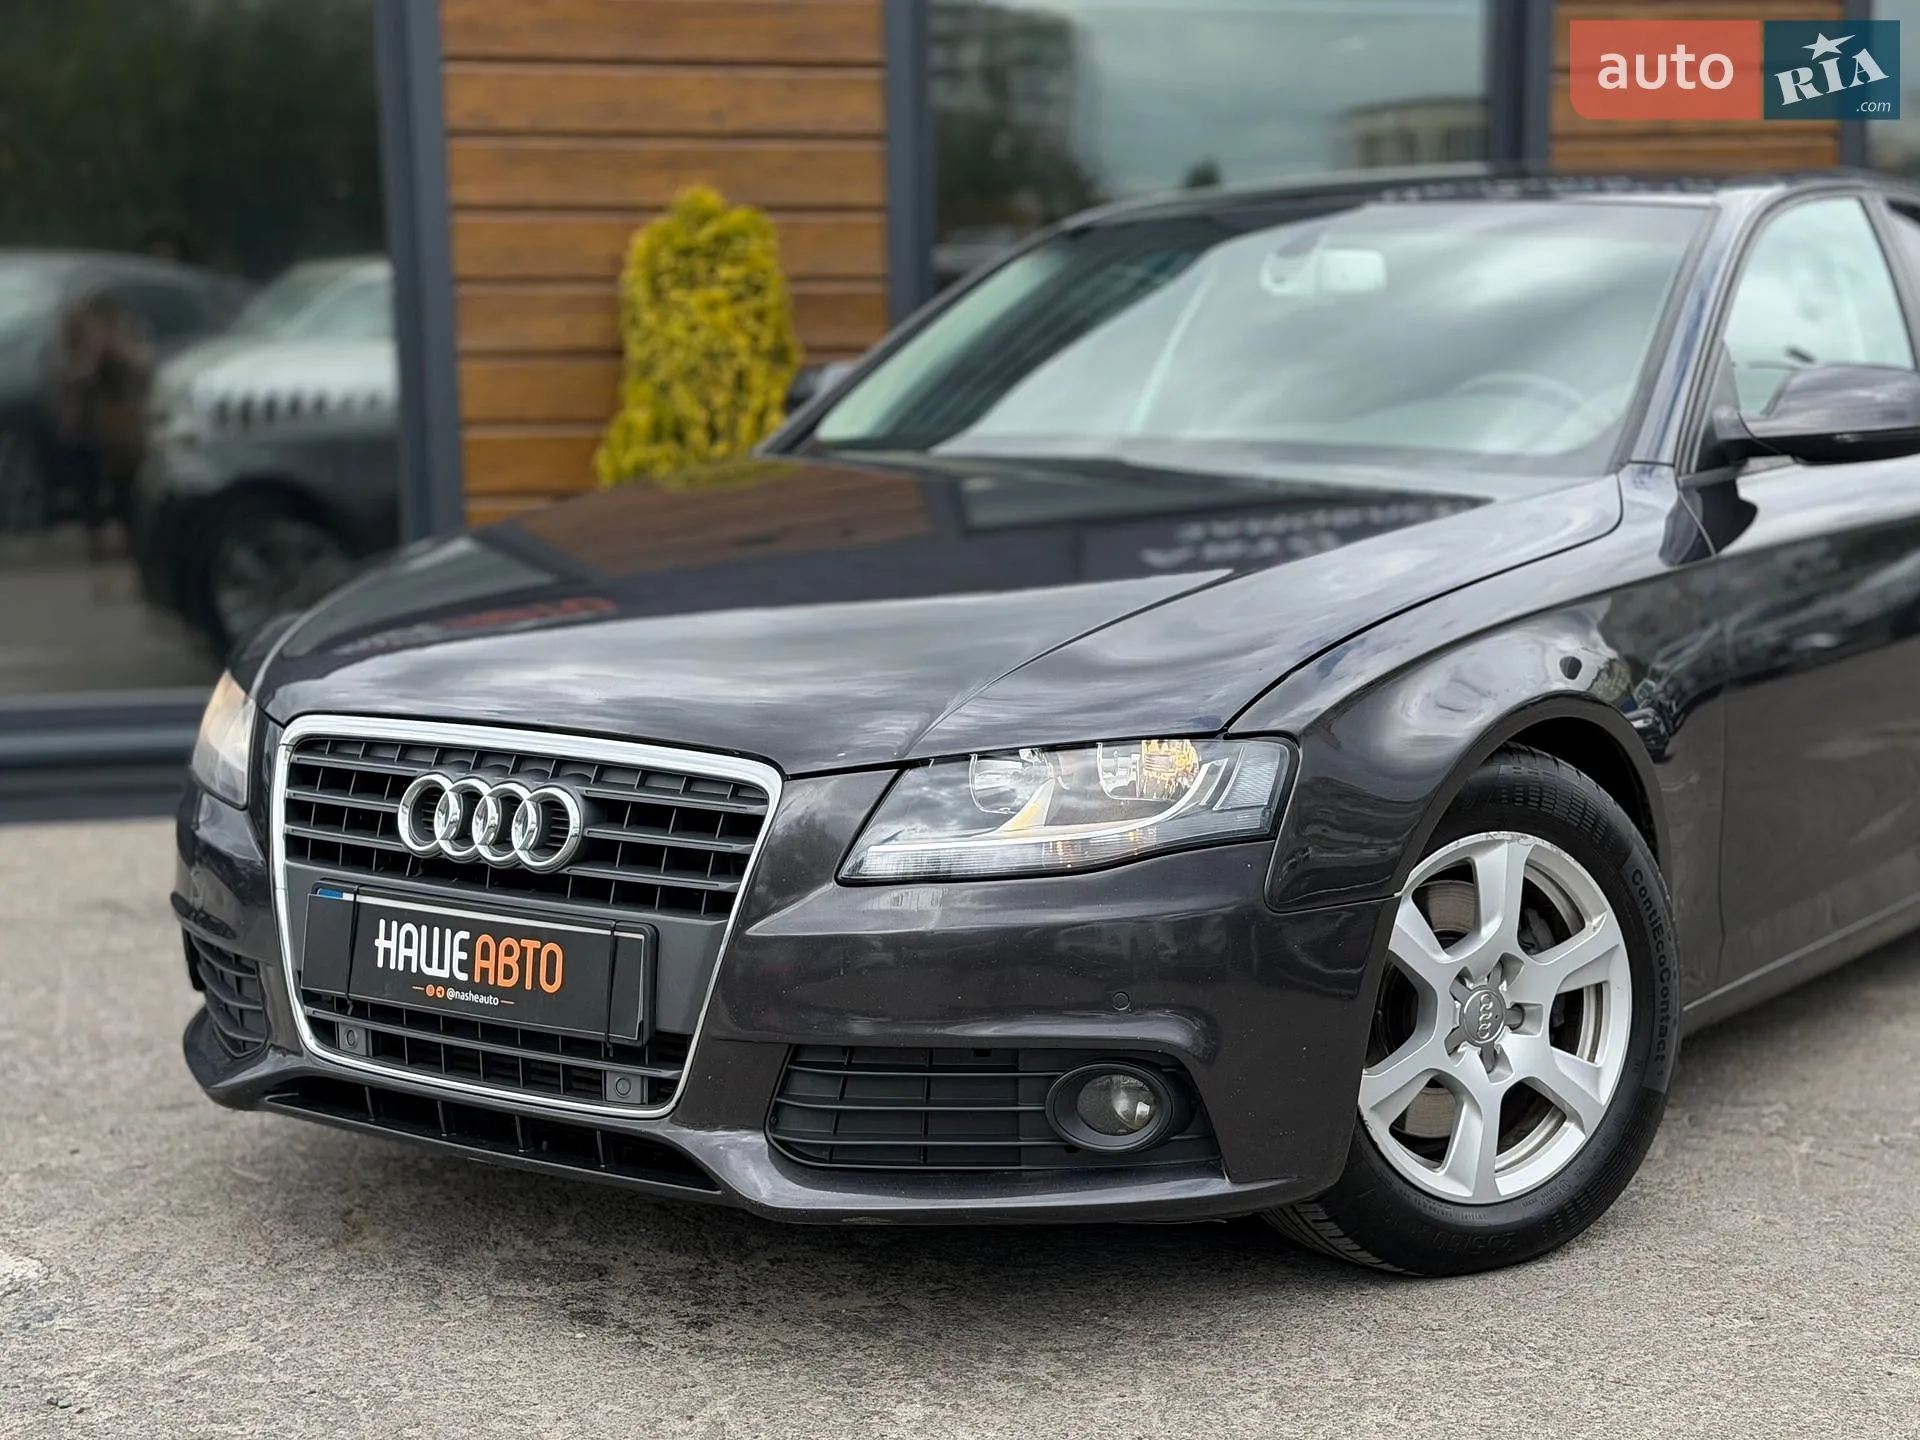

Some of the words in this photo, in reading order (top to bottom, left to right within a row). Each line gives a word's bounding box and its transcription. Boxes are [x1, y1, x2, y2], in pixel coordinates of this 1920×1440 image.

[374, 918, 471, 982] НАШЕ
[474, 933, 564, 994] АВТО
[1631, 868, 1671, 1062] ContiEcoContact
[446, 987, 499, 1006] @nasheauto
